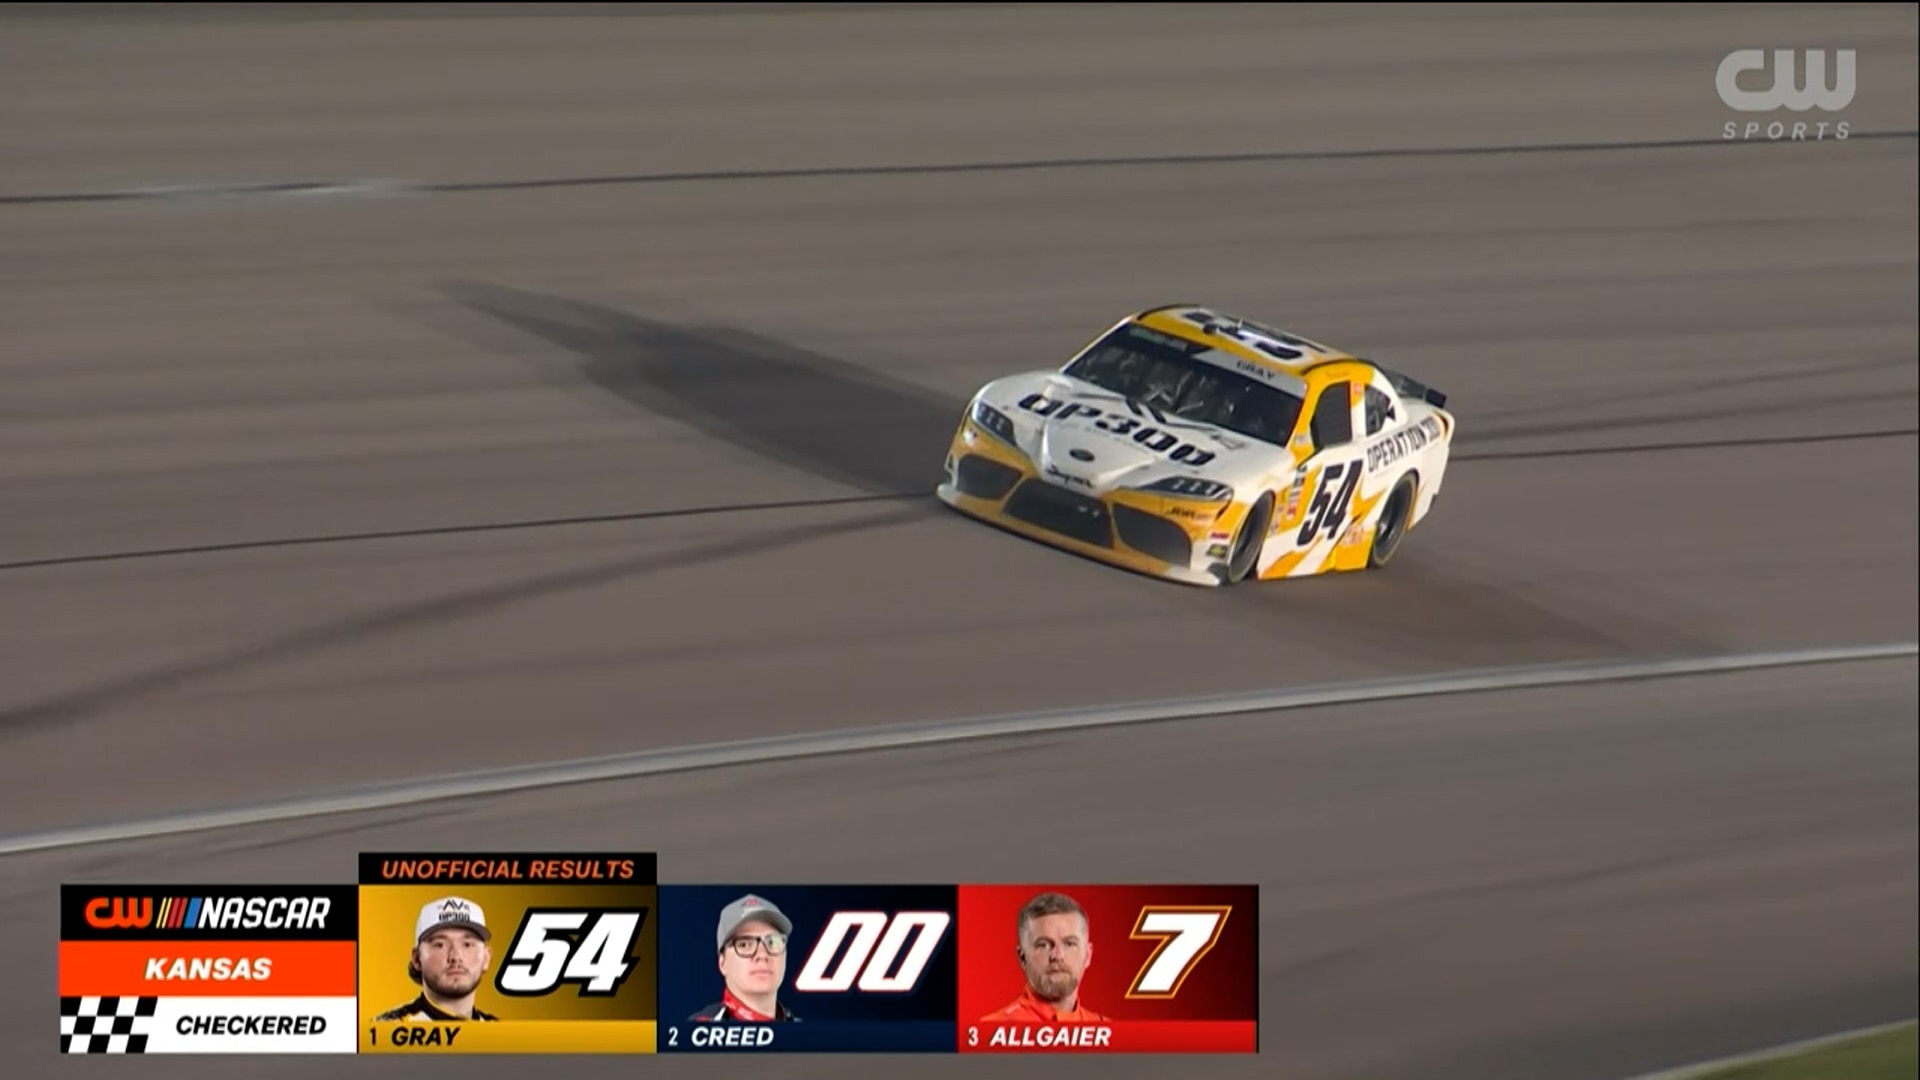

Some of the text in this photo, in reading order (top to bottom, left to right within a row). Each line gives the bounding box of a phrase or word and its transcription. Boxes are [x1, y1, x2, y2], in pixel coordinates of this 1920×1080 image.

[1236, 359, 1276, 381] GRAY
[1018, 393, 1216, 466] OP300
[1366, 423, 1427, 473] OPERATION
[1296, 458, 1364, 547] 54
